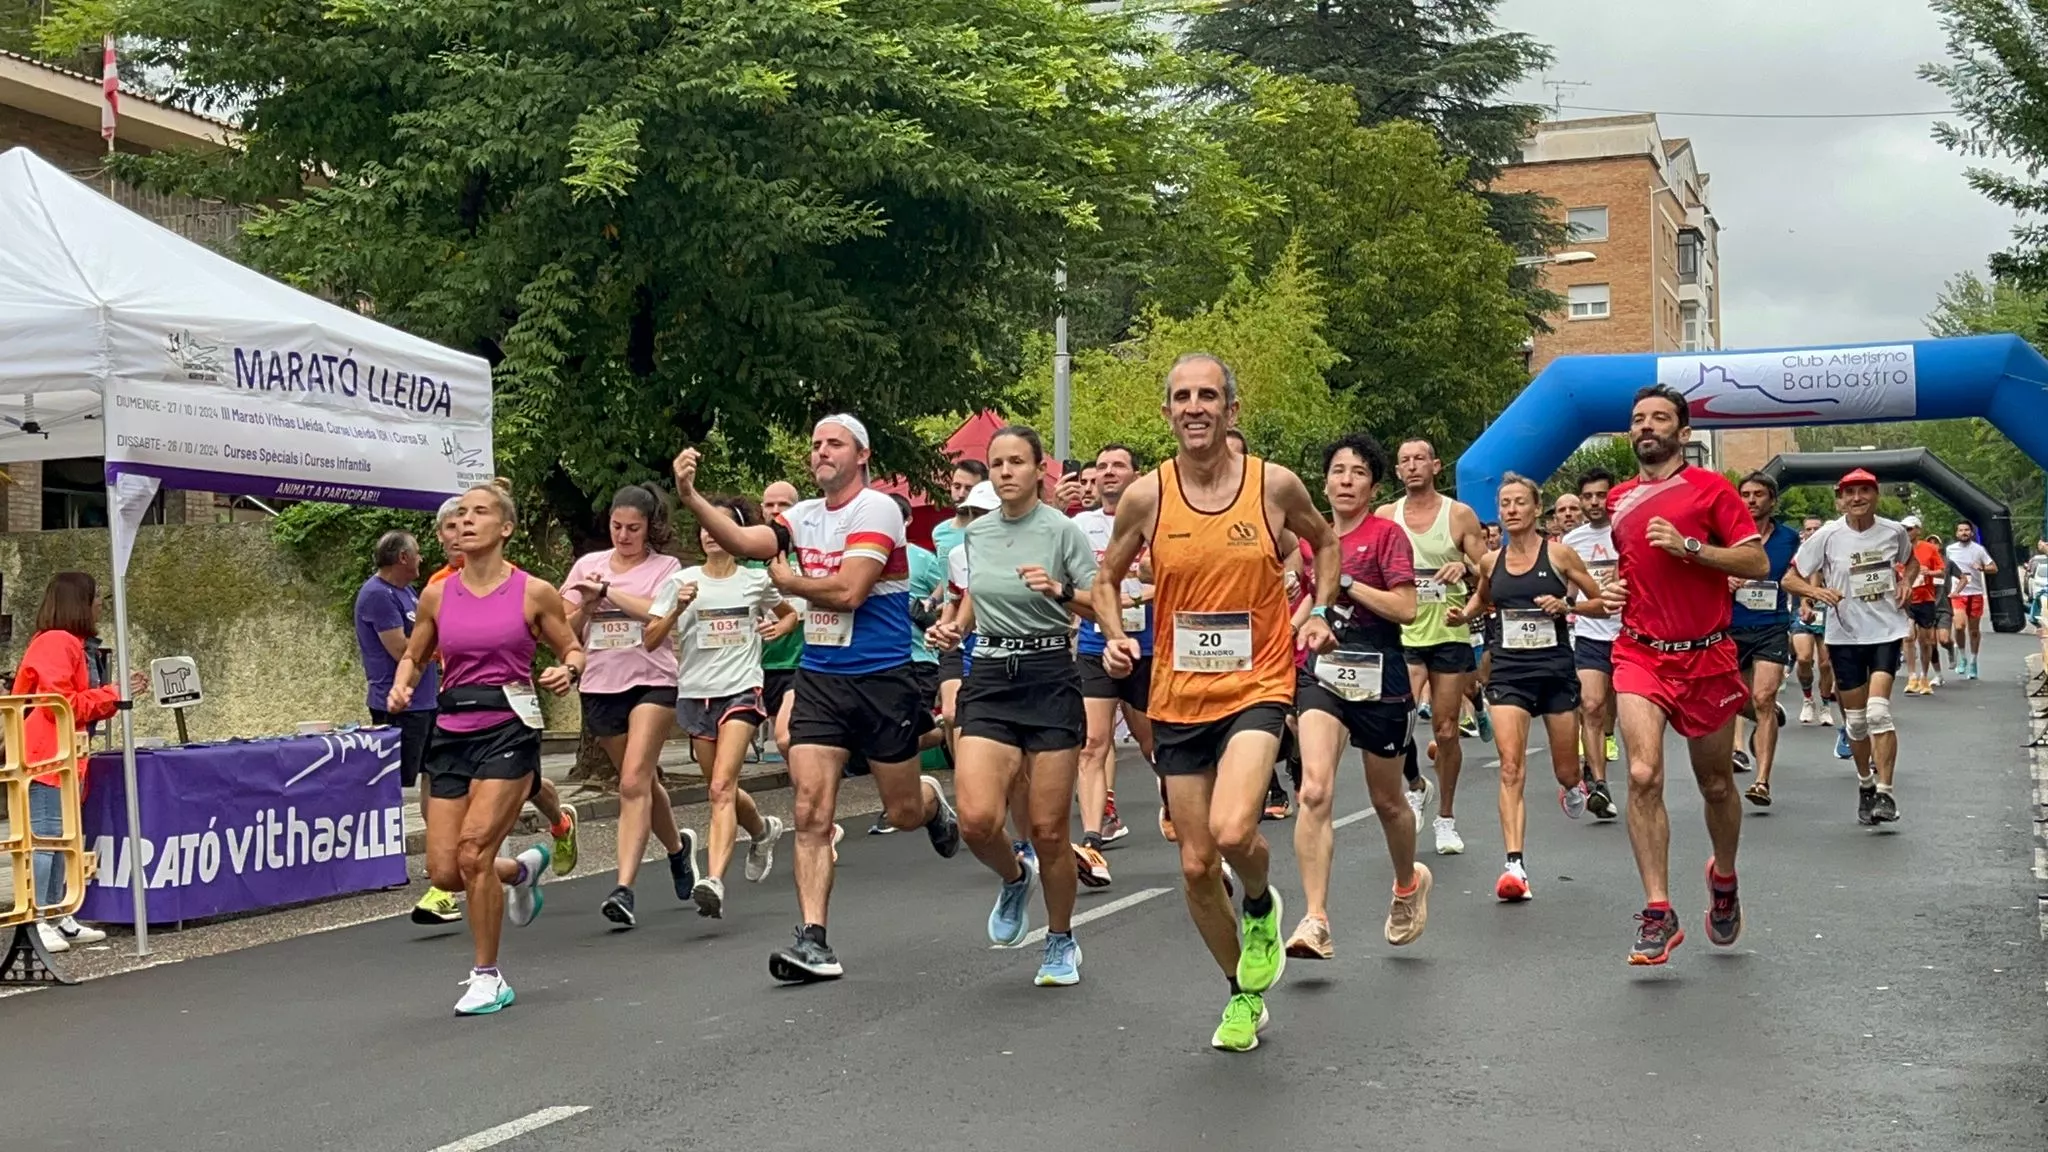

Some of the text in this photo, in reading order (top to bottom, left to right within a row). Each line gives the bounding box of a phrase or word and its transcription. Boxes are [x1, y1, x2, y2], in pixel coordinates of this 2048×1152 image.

[1782, 351, 1907, 369] Club Atletismo
[233, 347, 452, 417] MARATÓ LLEIDA
[1783, 370, 1908, 391] Barbastro
[116, 395, 161, 412] DIUMENGE
[167, 402, 176, 414] 27
[184, 405, 193, 416] 10
[200, 406, 218, 419] 2024
[221, 406, 230, 420] III
[231, 408, 264, 424] Marató
[265, 413, 295, 429] Vithas
[296, 417, 326, 434] Lleida,
[117, 434, 161, 450] DISSABTE
[168, 440, 177, 452] 26
[185, 442, 193, 454] 10
[200, 443, 219, 456] 2024
[224, 444, 258, 461] Curses
[304, 453, 336, 469] Curses
[336, 456, 371, 472] Infantils
[314, 485, 321, 497] A
[322, 487, 380, 502] PARTICIPAR!!
[1416, 580, 1430, 588] 22
[1866, 573, 1879, 581] 28
[709, 620, 739, 631] 1031
[809, 613, 839, 625] 1006
[602, 622, 629, 633] 1033
[1521, 622, 1536, 632] 49
[1199, 633, 1222, 647] 20
[1337, 668, 1356, 680] 23
[82, 816, 220, 889] ARATÓ
[226, 806, 354, 874] vithas
